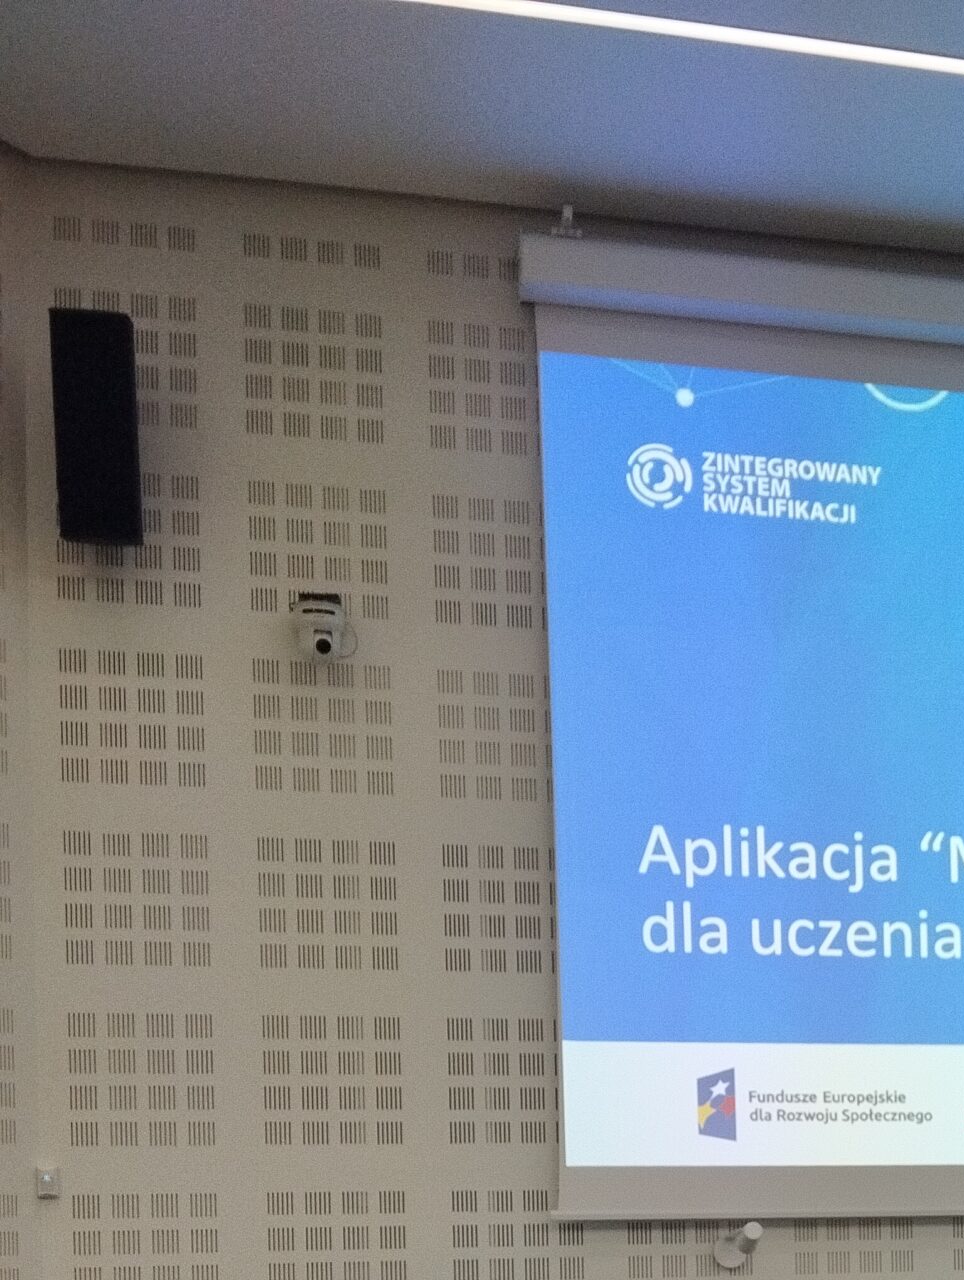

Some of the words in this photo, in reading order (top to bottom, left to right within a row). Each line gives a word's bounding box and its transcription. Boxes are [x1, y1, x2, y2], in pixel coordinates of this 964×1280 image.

[702, 451, 881, 486] ZINTEGROWANY
[703, 473, 791, 498] SYSTEM
[703, 493, 856, 523] KWALIFIKACJI
[638, 823, 899, 893] Aplikacja
[642, 900, 728, 955] dla
[750, 909, 963, 960] uczenia
[749, 1090, 817, 1104] Fundusze
[823, 1090, 906, 1105] Europejskie
[750, 1108, 772, 1121] dla
[777, 1108, 838, 1124] Rozwoju
[842, 1108, 932, 1124] Społecznego
